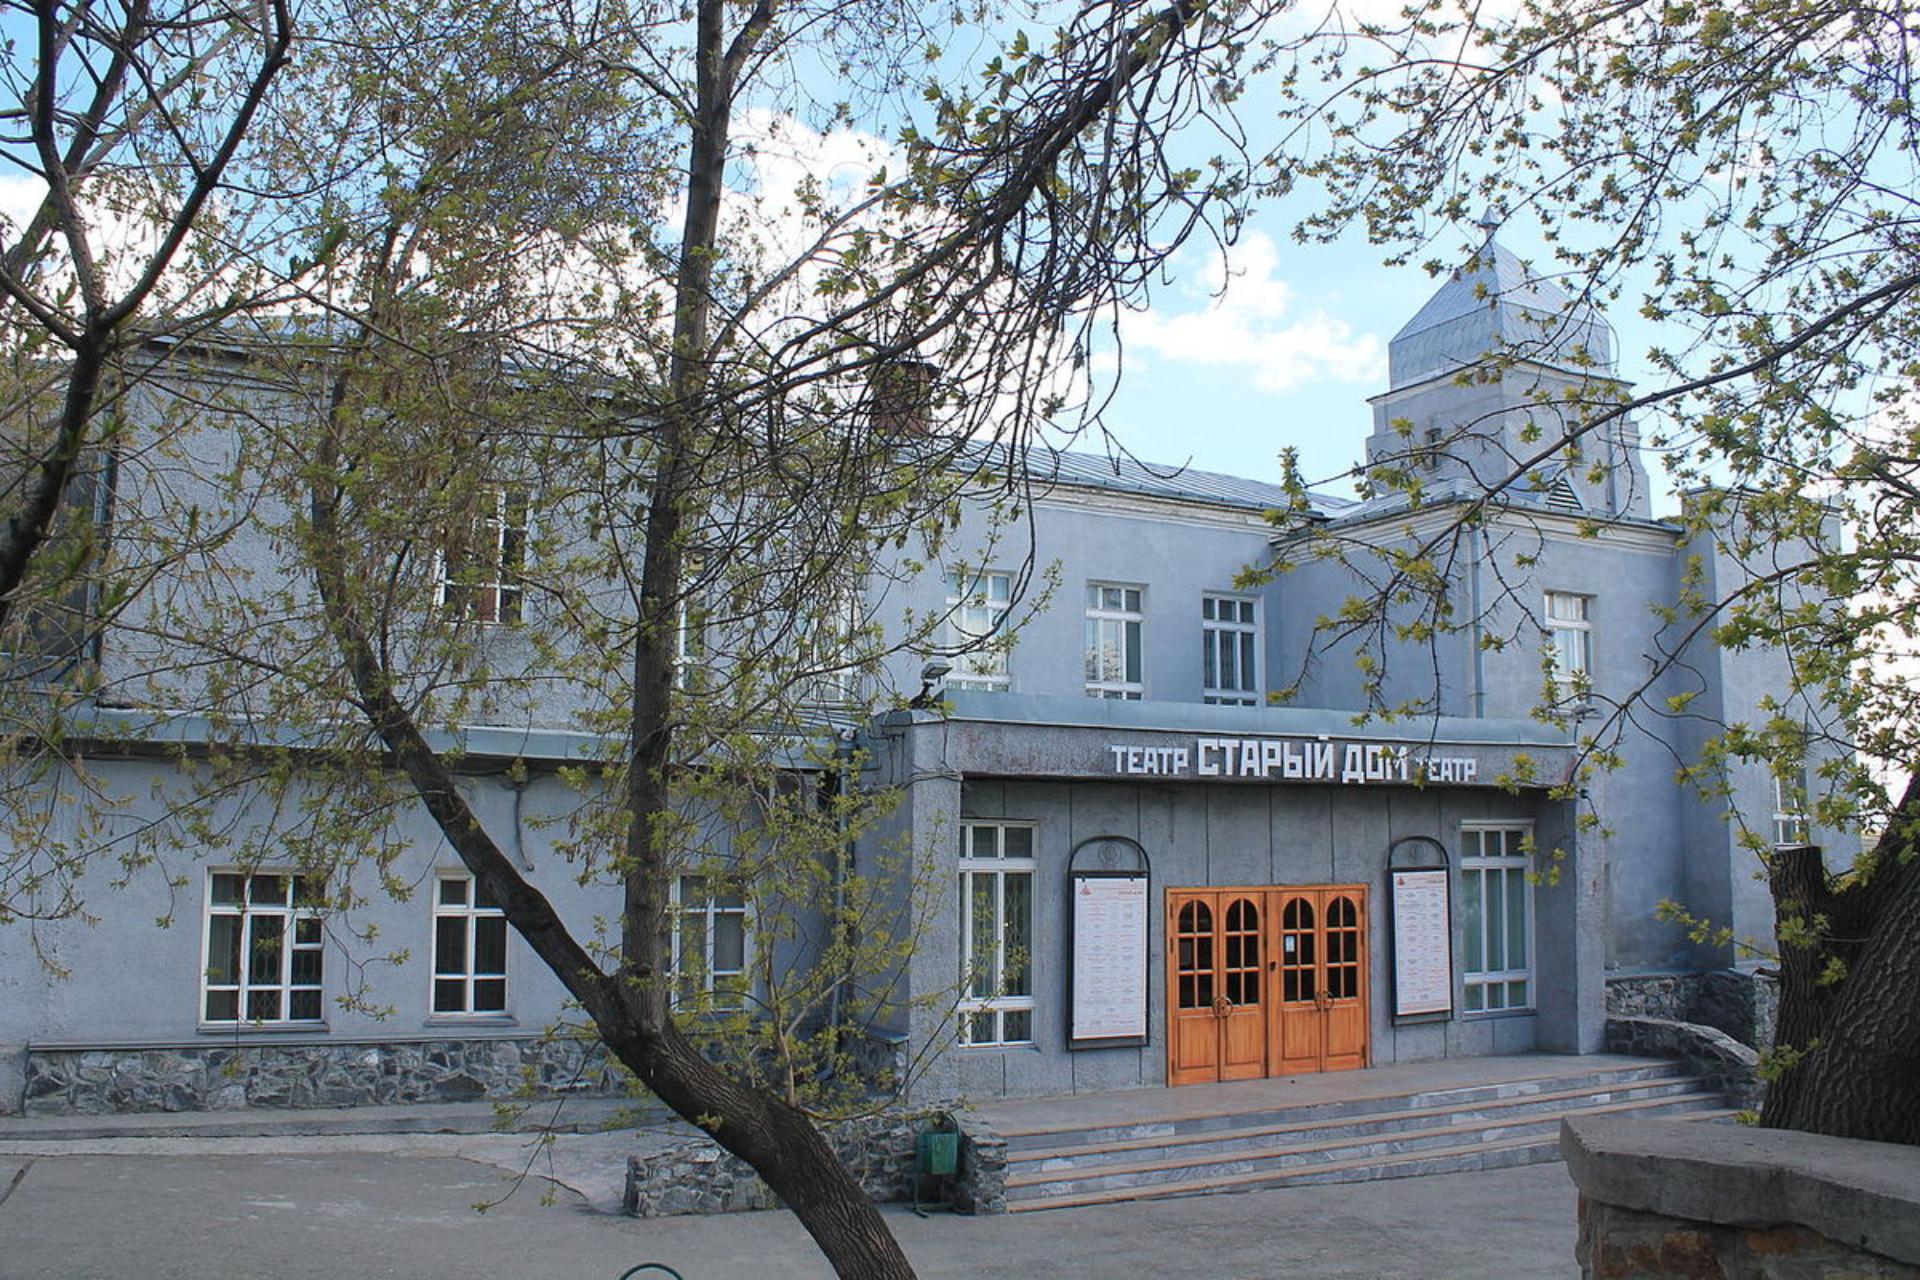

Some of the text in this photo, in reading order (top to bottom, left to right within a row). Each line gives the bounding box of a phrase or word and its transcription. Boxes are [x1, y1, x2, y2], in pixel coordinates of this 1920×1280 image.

[1111, 745, 1188, 775] ТЕАТР
[1197, 735, 1334, 779] СТАРЫЙ
[1342, 744, 1408, 784] ДОМ
